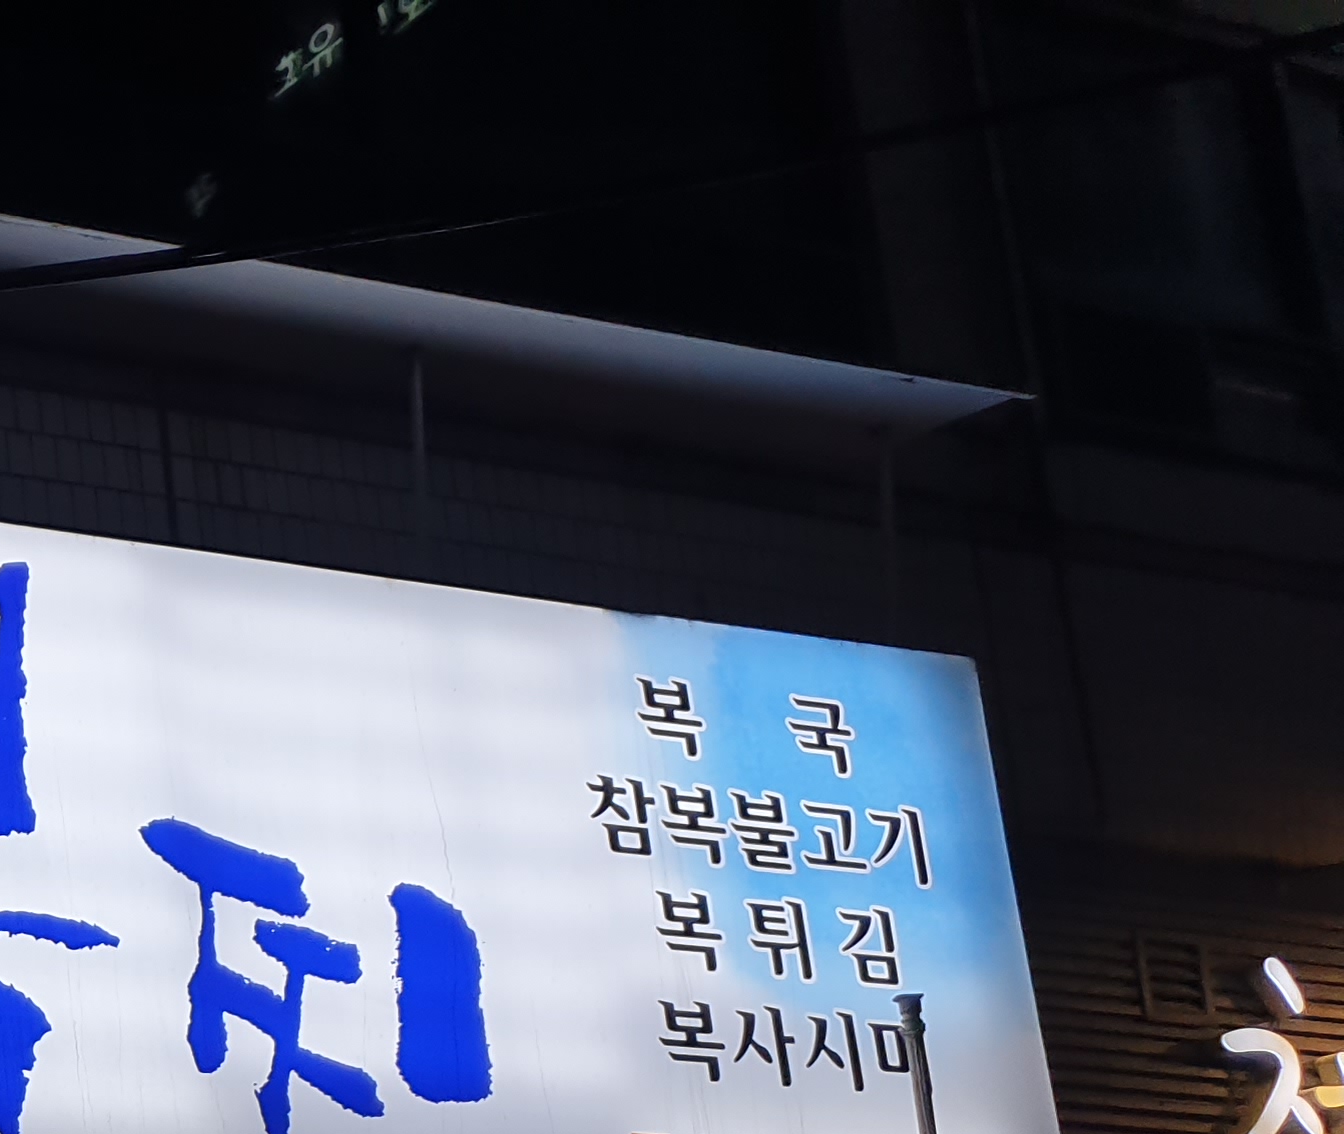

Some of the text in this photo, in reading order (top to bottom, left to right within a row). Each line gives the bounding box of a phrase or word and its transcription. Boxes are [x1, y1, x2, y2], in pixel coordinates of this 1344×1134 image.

[637, 676, 854, 777] 복 국
[587, 773, 931, 888] 참복불고기
[655, 890, 902, 989] 복 튀 김
